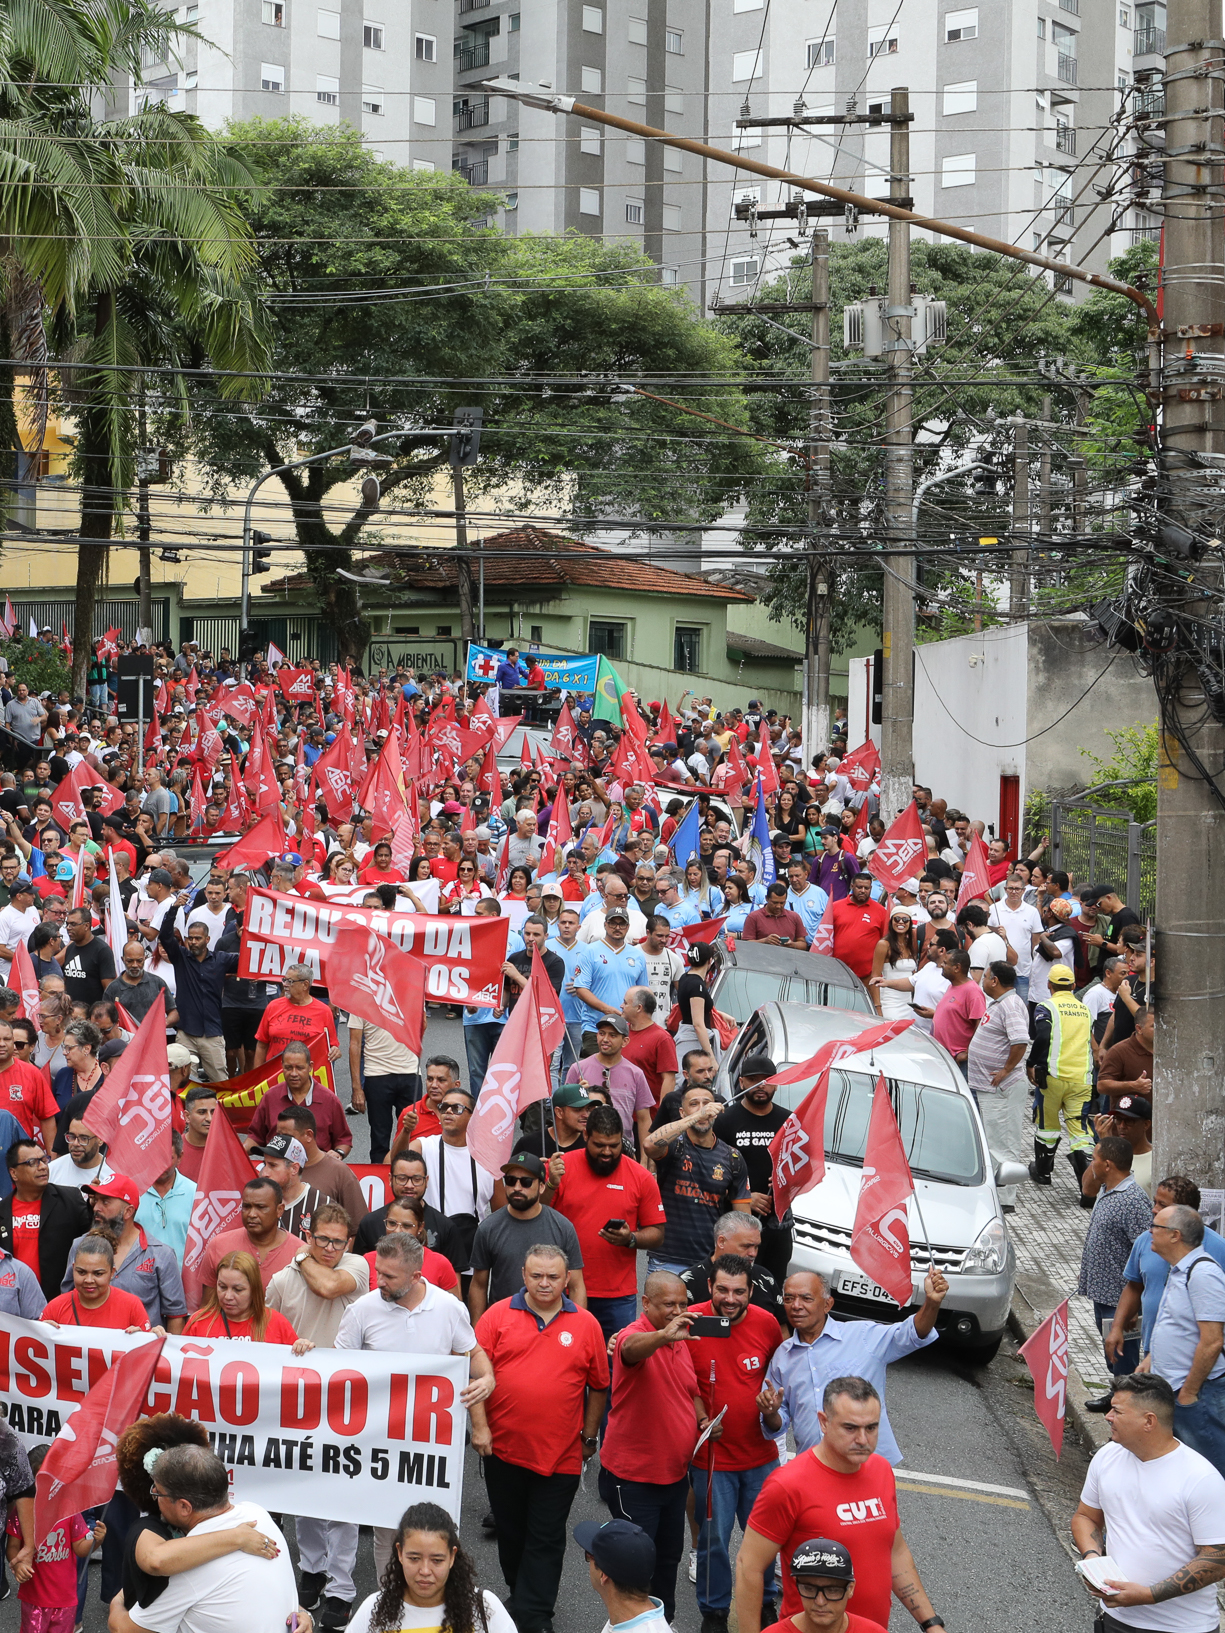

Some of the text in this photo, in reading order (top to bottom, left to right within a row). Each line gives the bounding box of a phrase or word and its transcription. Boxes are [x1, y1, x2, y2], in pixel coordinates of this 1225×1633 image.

[387, 644, 447, 669] AMBIENTAL
[552, 659, 568, 669] DA
[562, 673, 570, 683] 6
[288, 682, 314, 693] ABC
[250, 897, 472, 960] REDUÃO DA
[246, 940, 322, 981] TAXA
[65, 969, 86, 979] adidas
[471, 990, 499, 1004] ABC
[1060, 1010, 1089, 1018] TRÂNSITO
[736, 1138, 751, 1147] OS
[742, 1356, 760, 1371] 13
[280, 1365, 368, 1436] DO
[387, 1372, 455, 1446] IR
[0, 1401, 62, 1438] PARA
[262, 1435, 314, 1472] ATÉ
[322, 1444, 361, 1480] R$
[370, 1448, 390, 1482] 5
[397, 1451, 451, 1489] MIL
[836, 1497, 880, 1521] CUT
[35, 1545, 70, 1563] Barbie
